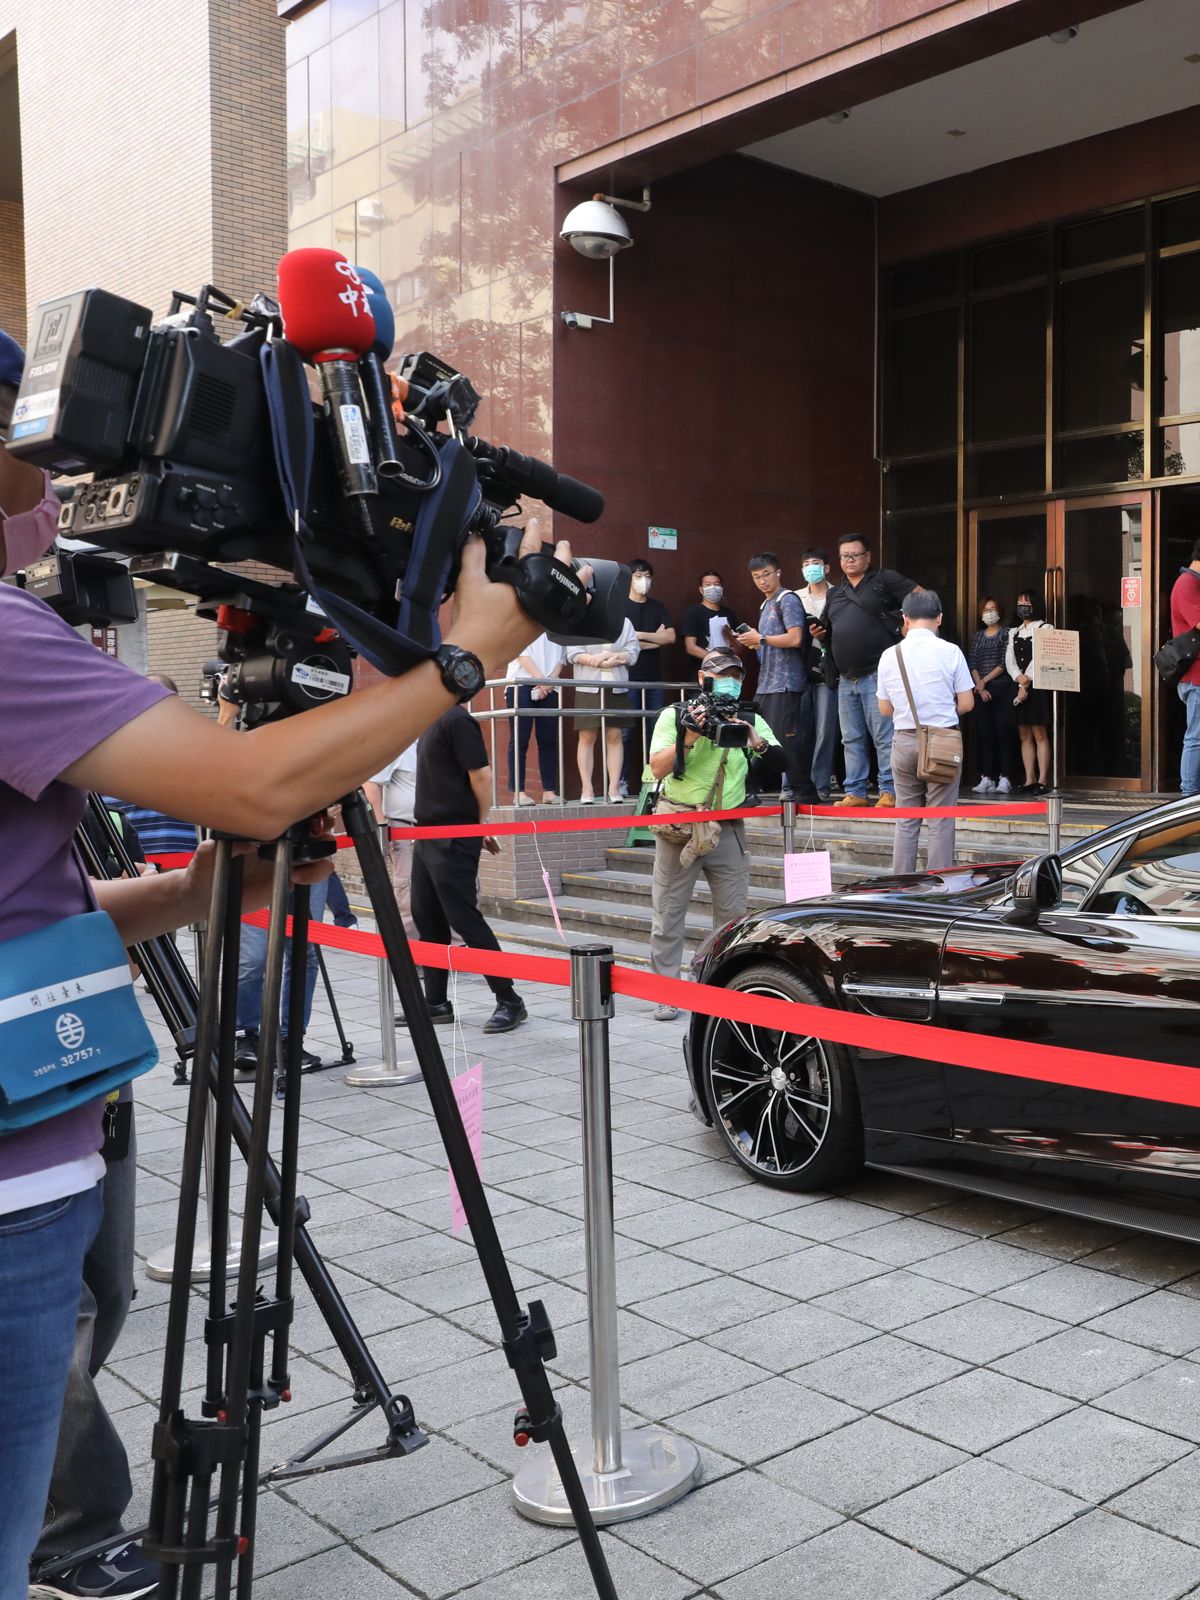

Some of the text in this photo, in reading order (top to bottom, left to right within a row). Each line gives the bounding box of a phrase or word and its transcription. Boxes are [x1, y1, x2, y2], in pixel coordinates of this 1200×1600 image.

[34, 581, 49, 589] SONY
[550, 567, 580, 596] FUJINON
[60, 1046, 94, 1068] 32757
